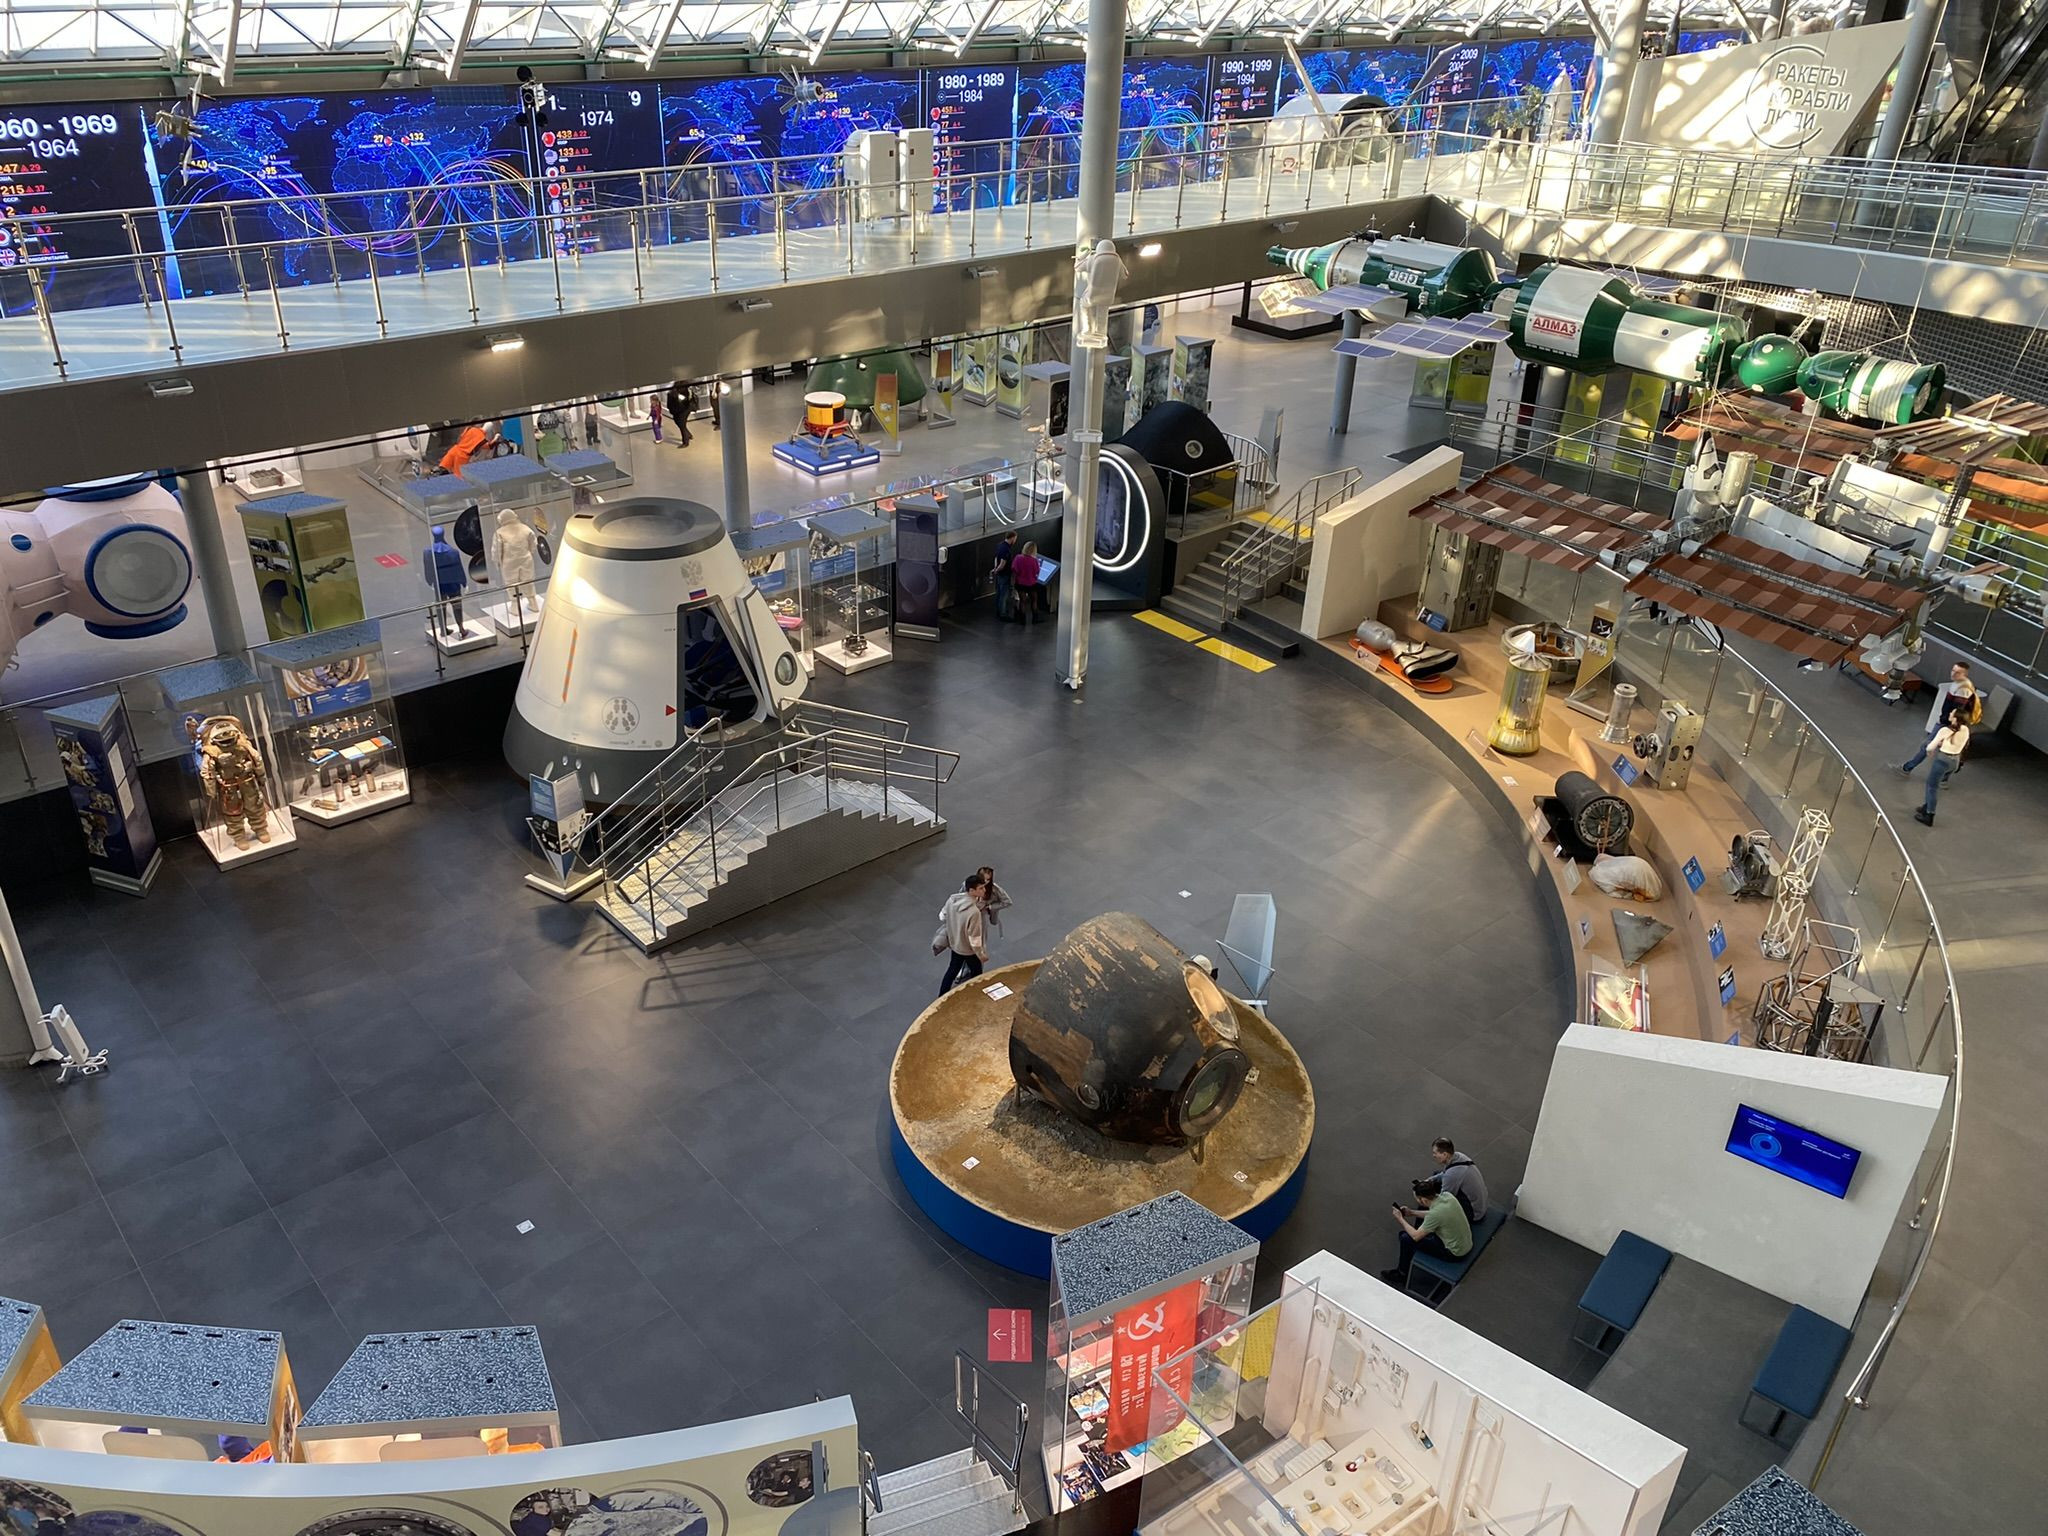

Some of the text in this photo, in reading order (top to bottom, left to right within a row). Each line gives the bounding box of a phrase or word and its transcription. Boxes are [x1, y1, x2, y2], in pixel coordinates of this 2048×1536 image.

[1460, 49, 1478, 59] 2009
[1222, 61, 1243, 73] 1990
[1251, 59, 1272, 71] 1999
[938, 75, 967, 89] 1980
[976, 73, 1004, 87] 1989
[1237, 74, 1255, 85] 1994
[1776, 63, 1846, 87] РАКЕТЫ
[959, 89, 983, 102] 1984
[58, 114, 118, 135] 1969
[580, 110, 614, 126] 1974
[27, 139, 80, 158] 1964
[0, 163, 18, 174] 47
[1, 184, 25, 196] 215
[1533, 318, 1577, 334] АЛМАЗ
